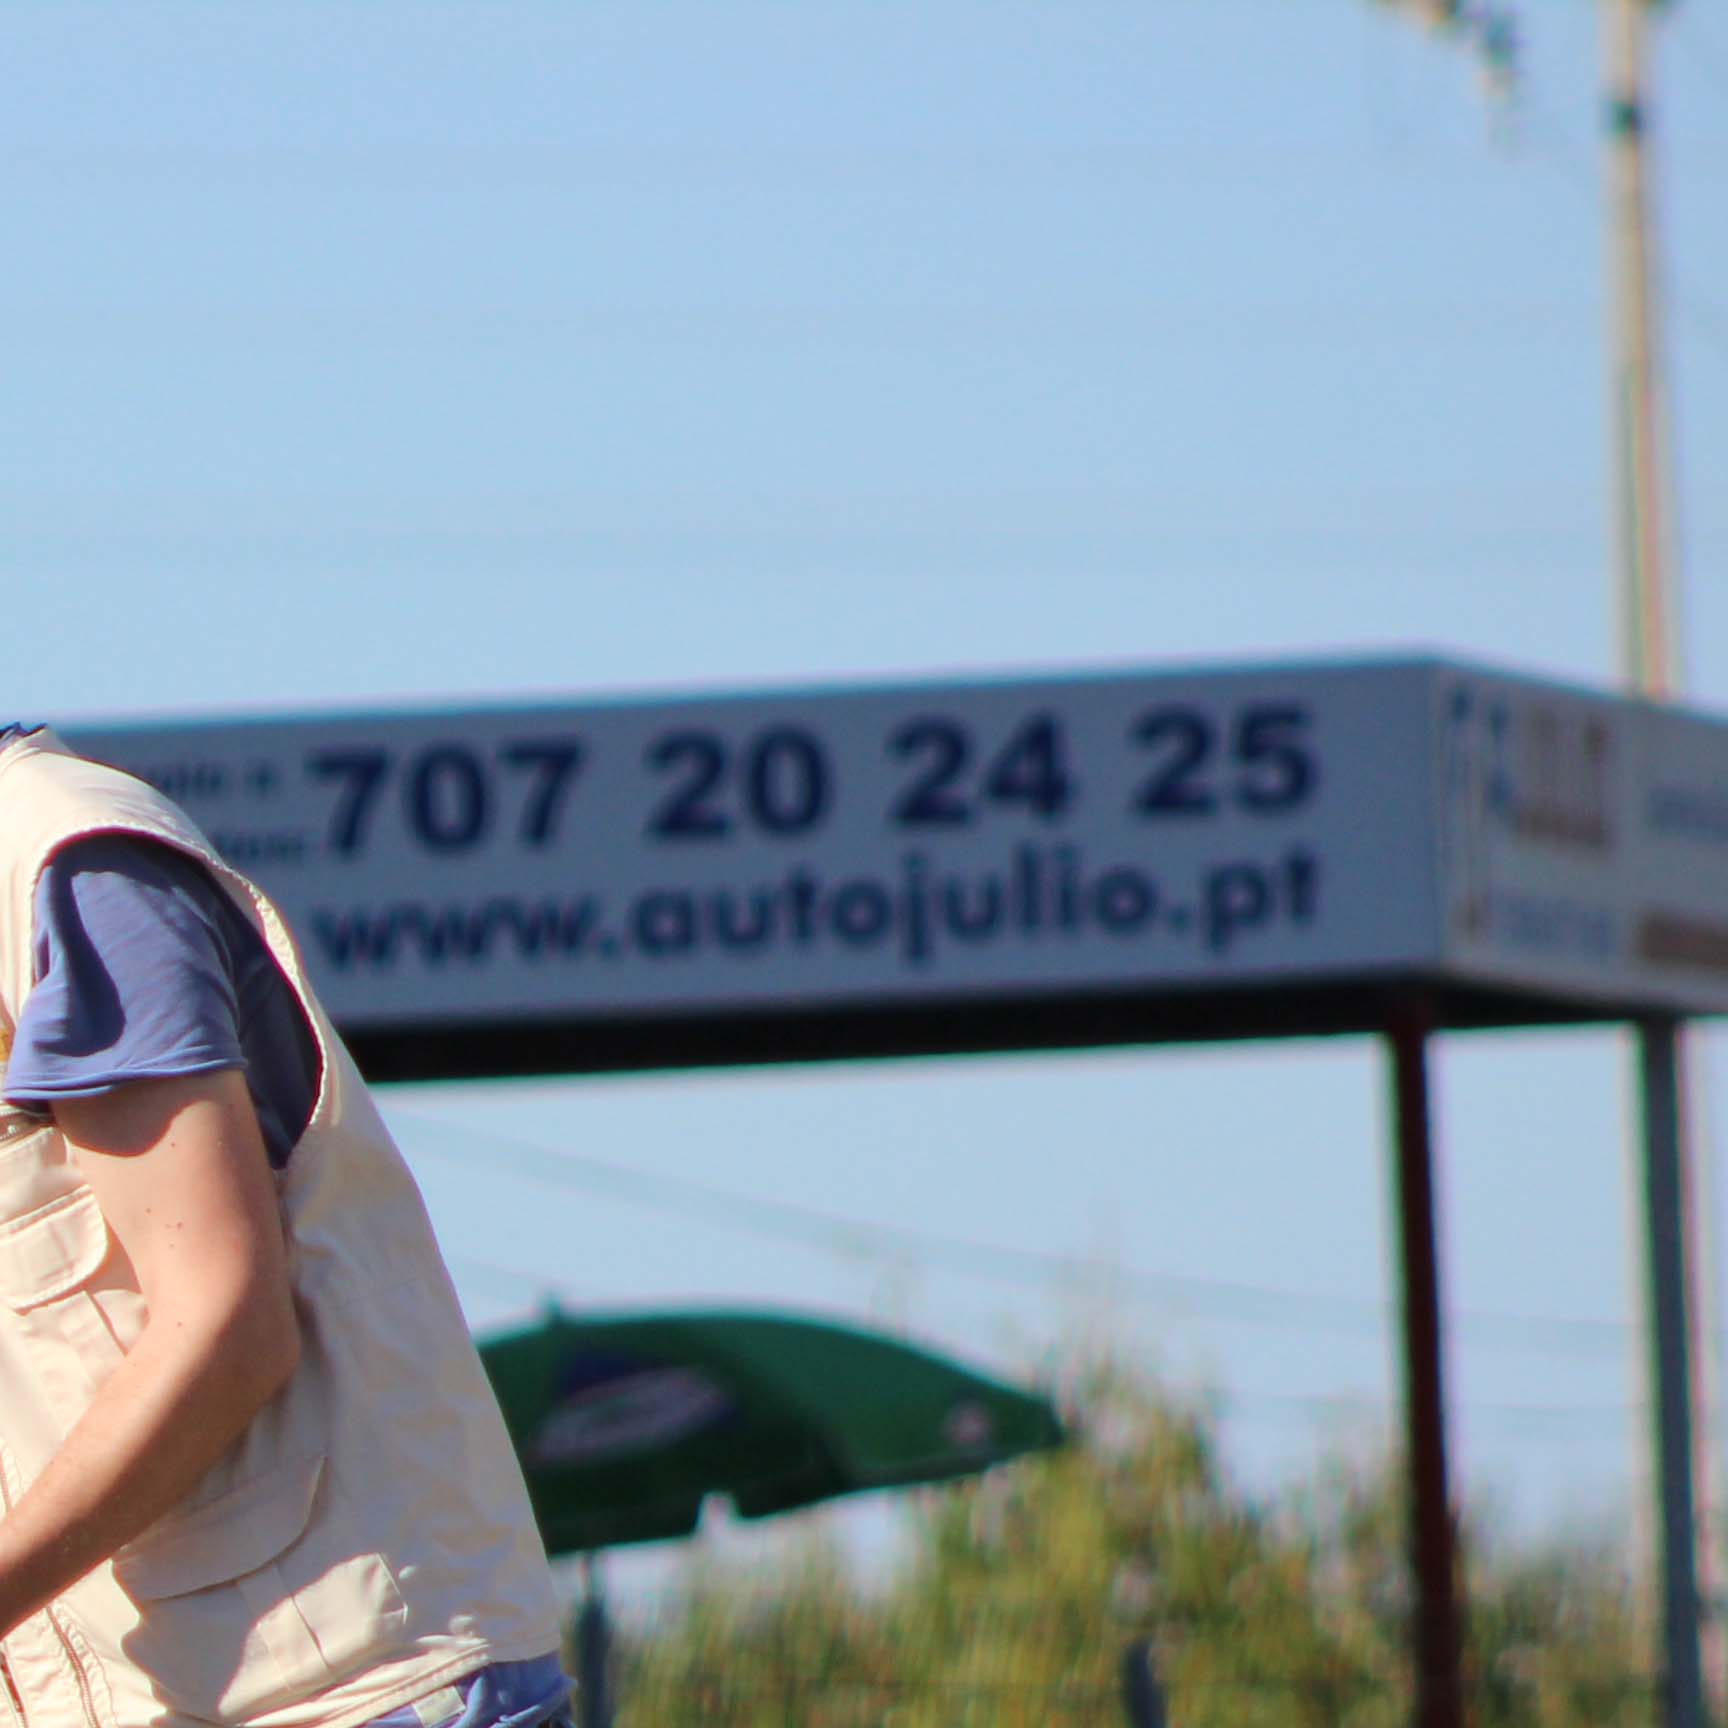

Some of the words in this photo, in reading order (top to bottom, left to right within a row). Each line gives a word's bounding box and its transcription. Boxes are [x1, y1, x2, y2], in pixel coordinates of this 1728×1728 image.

[308, 737, 584, 858] 707
[648, 724, 829, 841] 20
[890, 714, 1070, 825] 24
[1134, 706, 1316, 814] 25
[316, 843, 1319, 966] www.autojulio.pt
